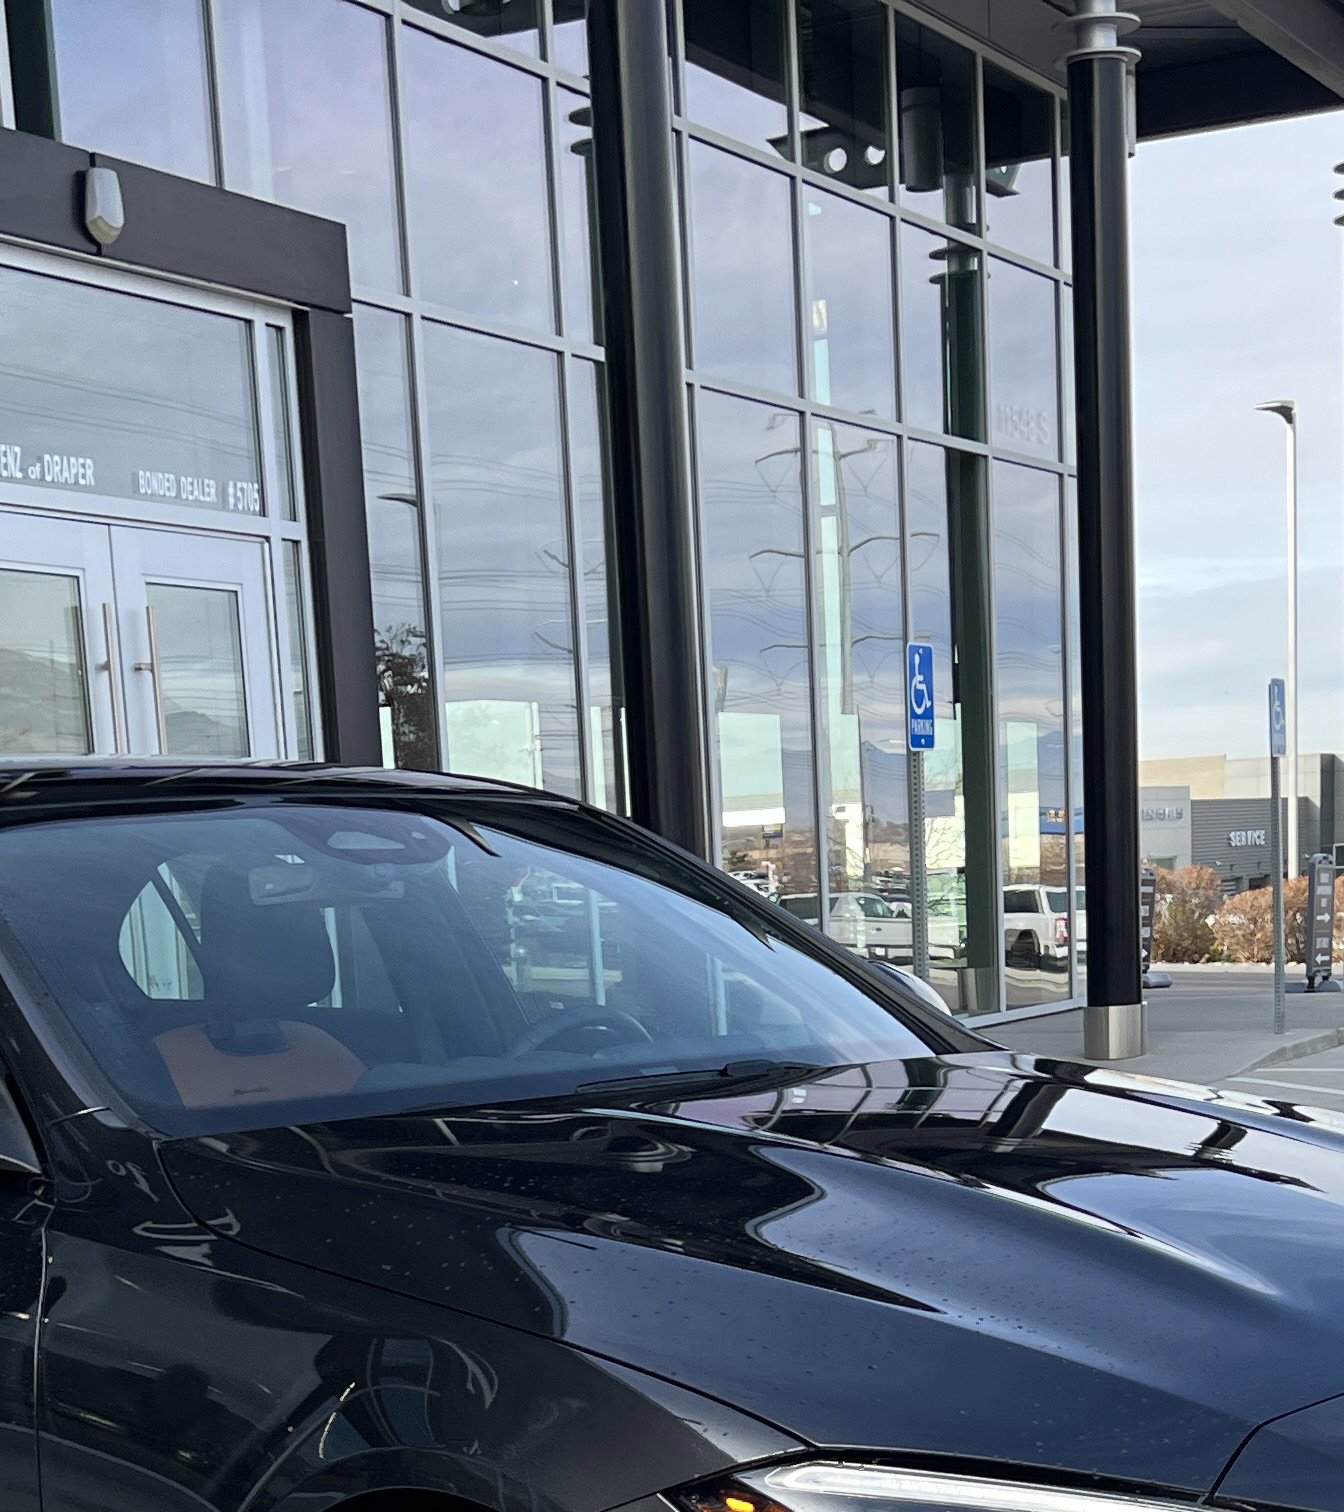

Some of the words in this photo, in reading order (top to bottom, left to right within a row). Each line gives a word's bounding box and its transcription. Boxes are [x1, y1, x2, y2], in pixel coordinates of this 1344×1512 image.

[28, 463, 41, 479] of
[44, 454, 95, 486] DRAPER
[138, 470, 176, 497] BONDED
[180, 476, 217, 503] DEALER
[911, 718, 933, 735] PARKING
